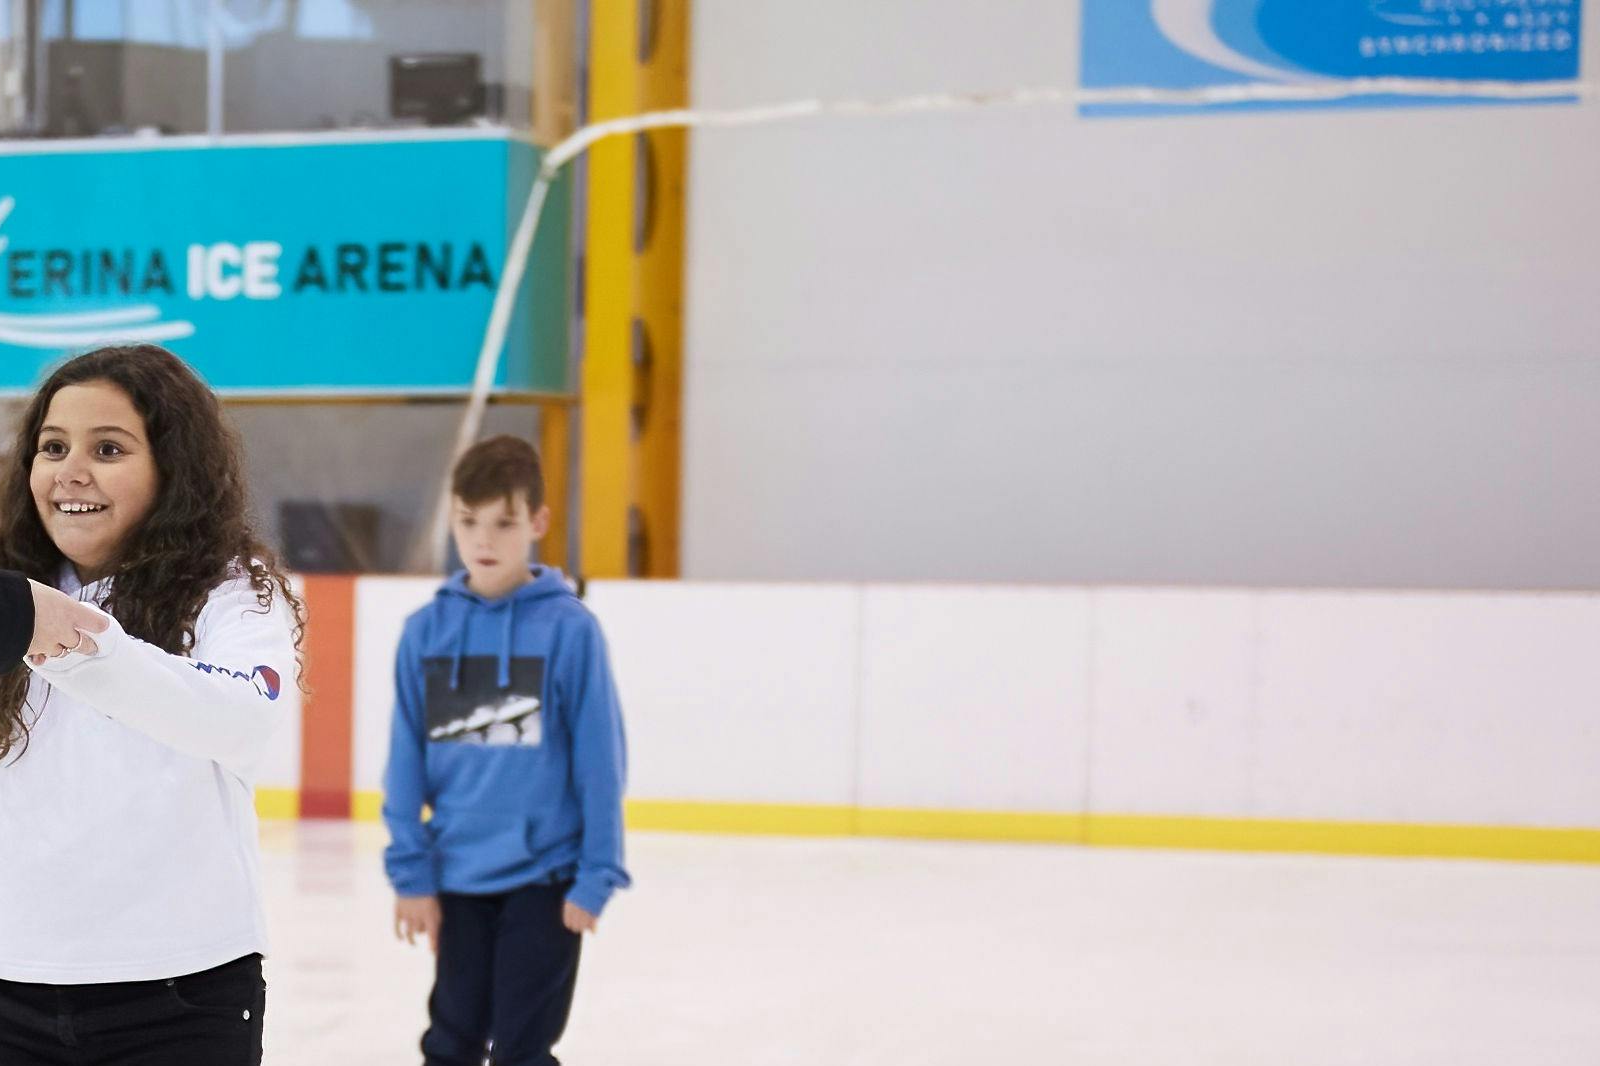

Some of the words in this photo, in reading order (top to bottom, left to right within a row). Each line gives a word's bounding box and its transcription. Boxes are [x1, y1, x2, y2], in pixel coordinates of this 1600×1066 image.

[7, 246, 175, 298] ERINA
[186, 241, 282, 300] ICE
[294, 241, 498, 293] ARENA
